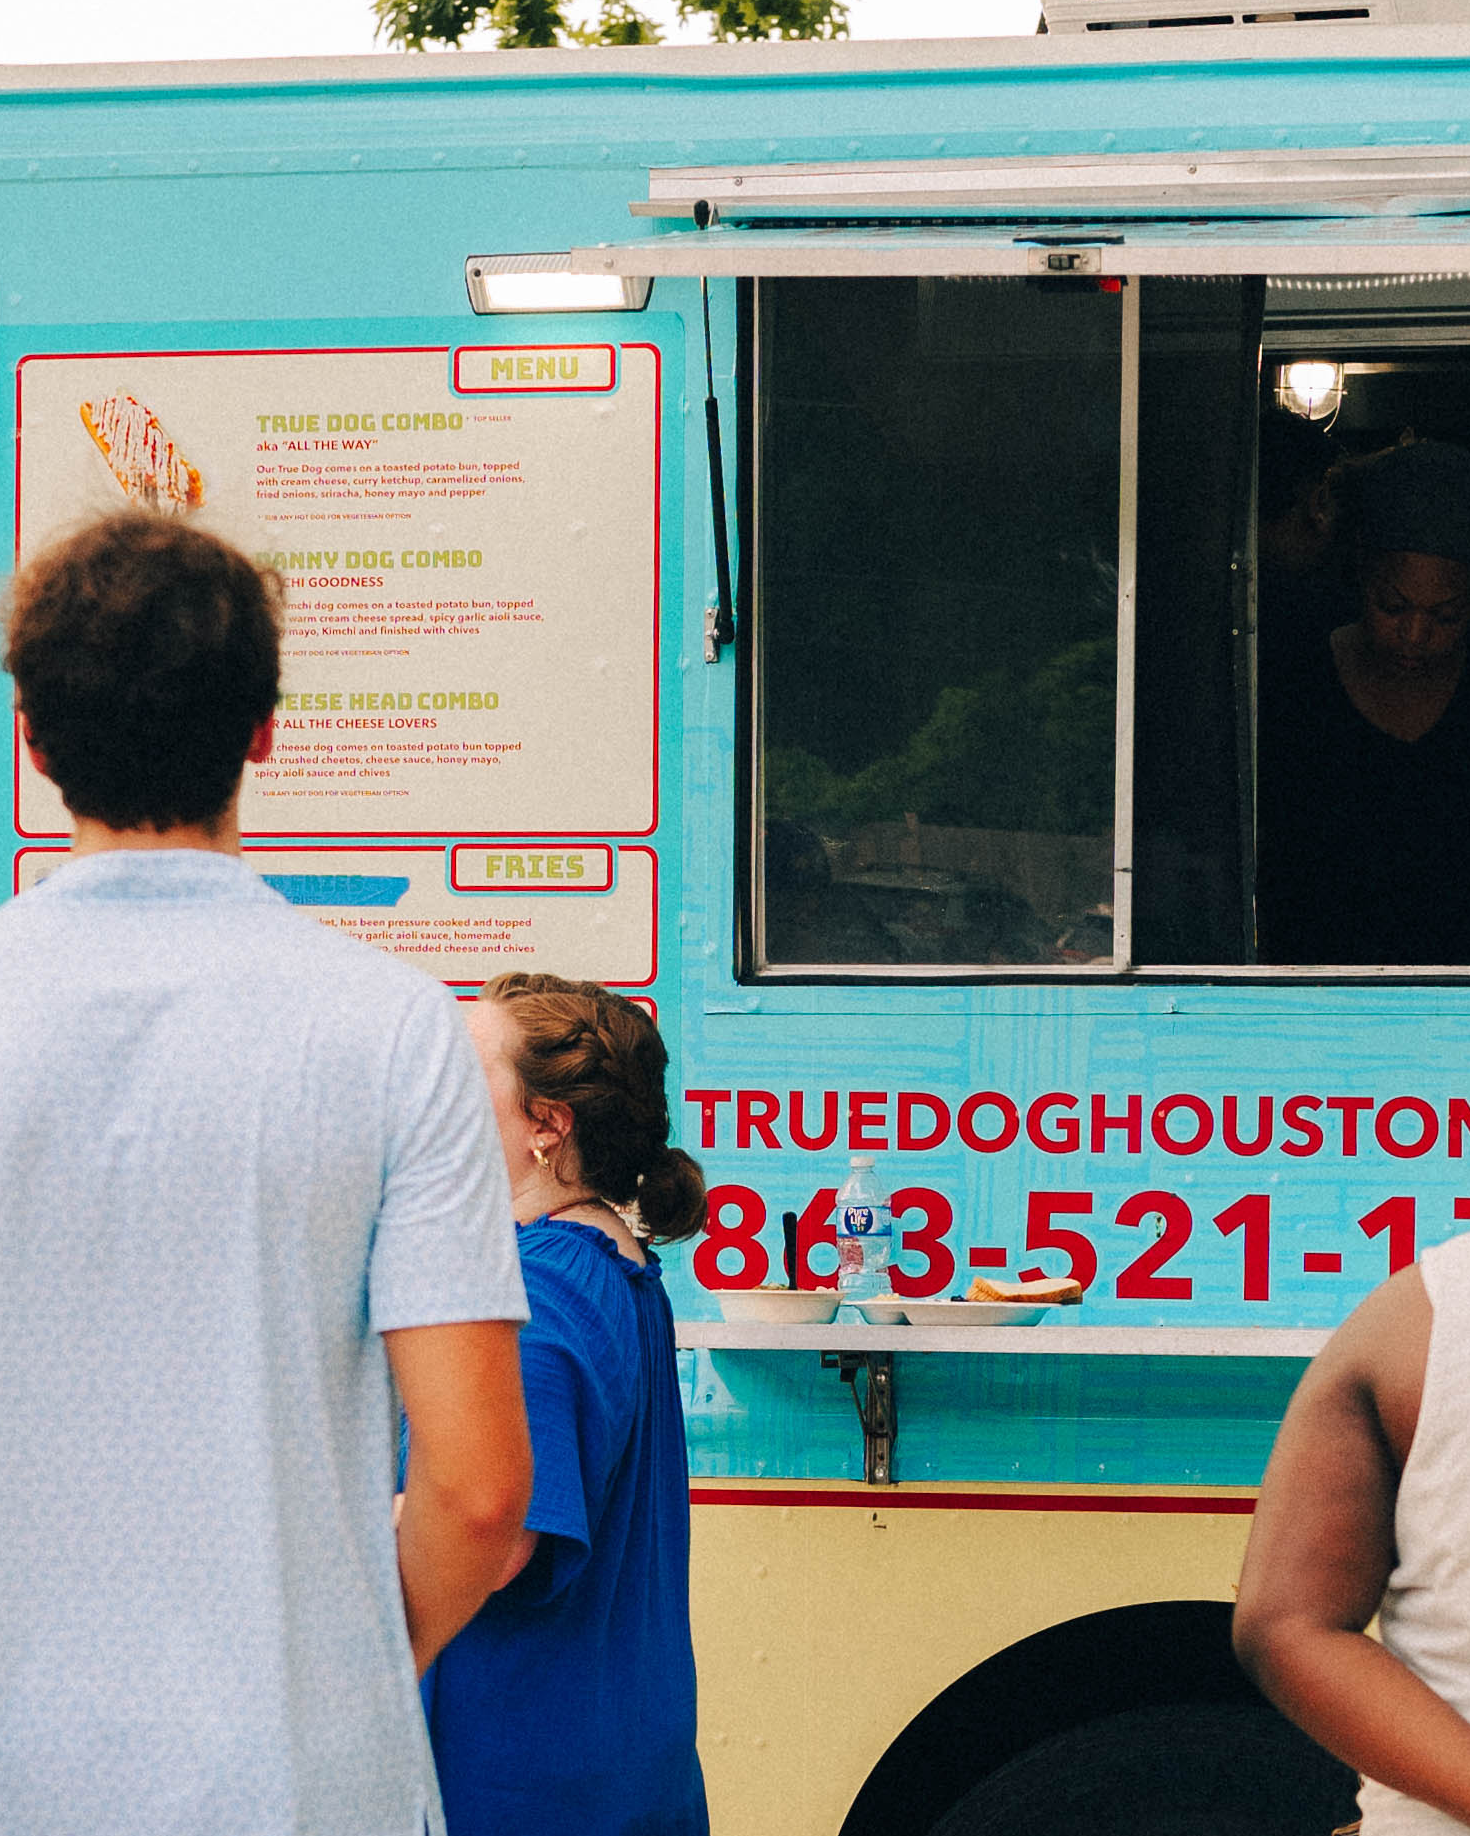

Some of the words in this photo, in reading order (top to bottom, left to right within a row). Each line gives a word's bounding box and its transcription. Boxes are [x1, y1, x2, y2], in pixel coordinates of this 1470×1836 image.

[491, 356, 579, 381] MENU
[256, 414, 319, 433] TRUE
[326, 413, 376, 432] DOG
[381, 412, 463, 431] COMBO
[255, 439, 279, 452] aka
[311, 439, 339, 452] THE
[255, 464, 276, 475] Our
[277, 464, 300, 474] True
[301, 463, 323, 476] Dog
[324, 465, 358, 473] comes
[358, 465, 373, 473] on
[382, 462, 421, 473] toasted
[422, 462, 457, 474] potato
[482, 460, 521, 474] topped
[255, 476, 279, 487] with
[279, 478, 312, 487] cream
[351, 477, 379, 488] curry
[425, 473, 488, 485] caramelized
[255, 489, 281, 500] fried
[363, 488, 396, 500] honey
[397, 490, 427, 500] mayo
[427, 487, 448, 498] and
[448, 489, 487, 500] pepper
[345, 550, 395, 569] DOG
[401, 549, 484, 569] COMBO
[308, 576, 384, 588] GOODNESS
[313, 600, 335, 613] dog
[335, 602, 370, 610] comes
[370, 602, 385, 610] on
[394, 599, 434, 610] toasted
[434, 600, 470, 612] potato
[495, 598, 535, 611] topped
[318, 615, 351, 623] cream
[351, 612, 388, 623] cheese
[429, 612, 456, 625] spicy
[457, 612, 486, 625] garlic
[488, 611, 511, 622] aioli
[321, 626, 357, 636] Kimchi
[358, 625, 378, 636] and
[379, 625, 421, 636] finished
[422, 625, 446, 635] with
[447, 625, 481, 635] chives
[279, 692, 342, 711] EESE
[349, 692, 412, 711] HEAD
[417, 691, 499, 711] COMBO
[282, 718, 308, 730] ALL
[307, 718, 334, 730] THE
[334, 717, 386, 730] CHEESE
[387, 717, 439, 730] LOVERS
[276, 743, 312, 752] cheese
[313, 742, 334, 754] dog
[335, 744, 369, 752] comes
[370, 744, 384, 752] on
[385, 741, 425, 752] toasted
[426, 742, 460, 754] potato
[462, 741, 483, 752] bun
[484, 741, 522, 754] topped
[260, 754, 277, 765] ith
[279, 754, 319, 765] crushed
[365, 754, 401, 765] cheese
[436, 754, 469, 767] honey
[254, 769, 281, 780] spicy
[282, 767, 305, 778] aioli
[305, 770, 336, 778] sauce
[336, 767, 357, 778] and
[357, 767, 391, 778] chives
[486, 855, 584, 879] FRIES
[339, 917, 358, 927] has
[359, 917, 386, 927] been
[387, 919, 432, 929] pressure
[433, 917, 471, 928] cooked
[473, 917, 493, 927] and
[494, 917, 532, 930] topped
[364, 930, 395, 943] garlic
[395, 930, 419, 940] aioli
[453, 930, 512, 941] homemade
[392, 943, 442, 954] shredded
[443, 943, 480, 954] cheese
[481, 943, 502, 953] and
[502, 943, 536, 954] chives
